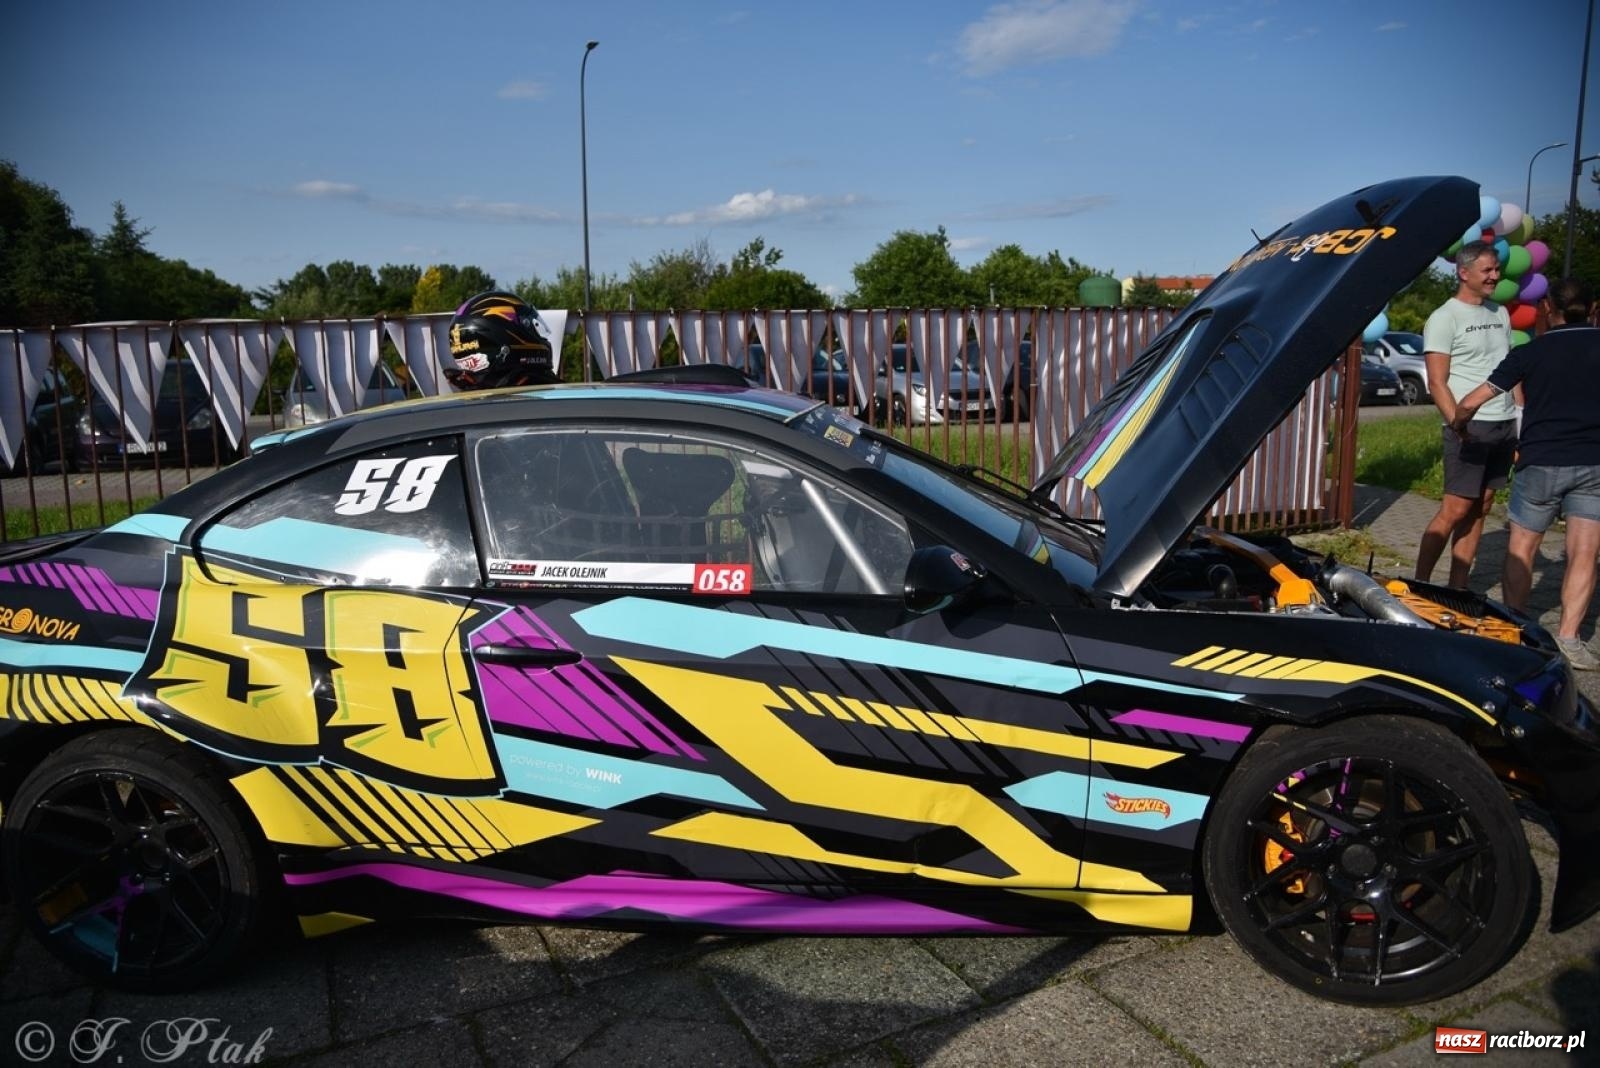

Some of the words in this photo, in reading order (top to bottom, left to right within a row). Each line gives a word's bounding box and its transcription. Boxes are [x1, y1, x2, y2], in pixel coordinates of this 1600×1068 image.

[1465, 324, 1504, 333] diverse
[334, 455, 459, 515] 58
[541, 566, 570, 578] JACEK
[569, 567, 608, 579] OLEJNIK
[698, 568, 746, 592] 058
[148, 555, 497, 780] 58
[509, 754, 564, 770] powered
[567, 760, 582, 777] by
[585, 767, 623, 785] WINK
[1115, 798, 1168, 814] STICKIES
